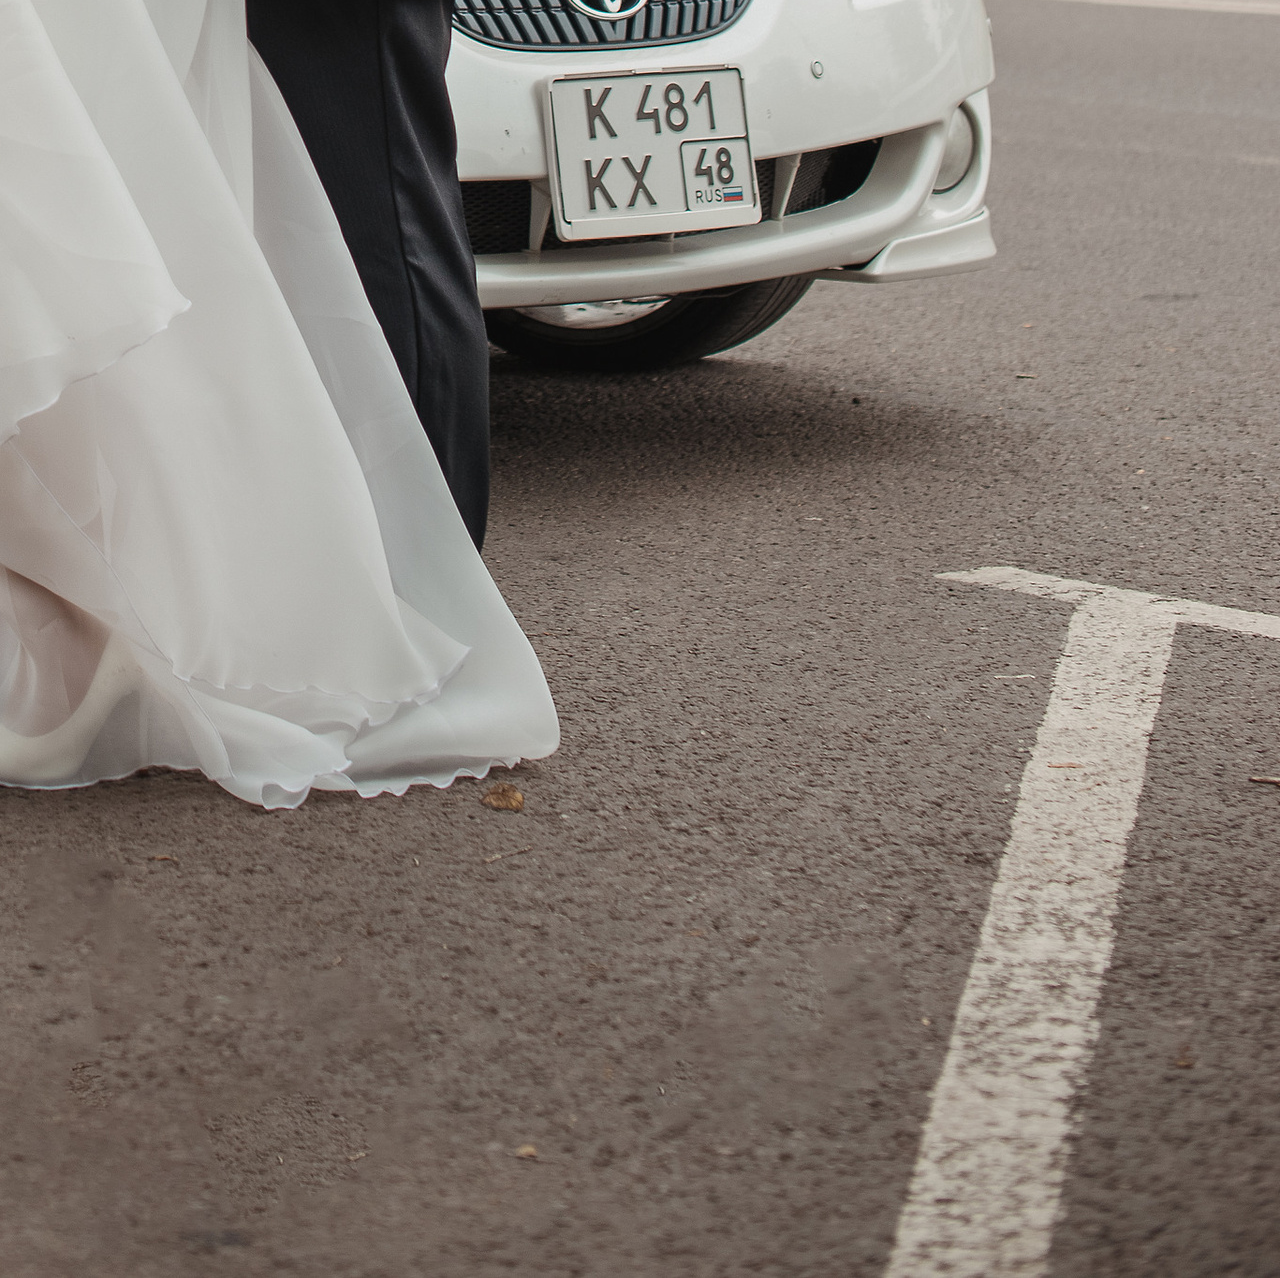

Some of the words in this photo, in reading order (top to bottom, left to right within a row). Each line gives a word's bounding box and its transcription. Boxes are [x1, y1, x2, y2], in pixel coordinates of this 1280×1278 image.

[583, 86, 618, 140] K
[636, 80, 716, 135] 481
[583, 154, 658, 211] KX
[694, 146, 735, 186] 48
[695, 188, 723, 204] RUS
